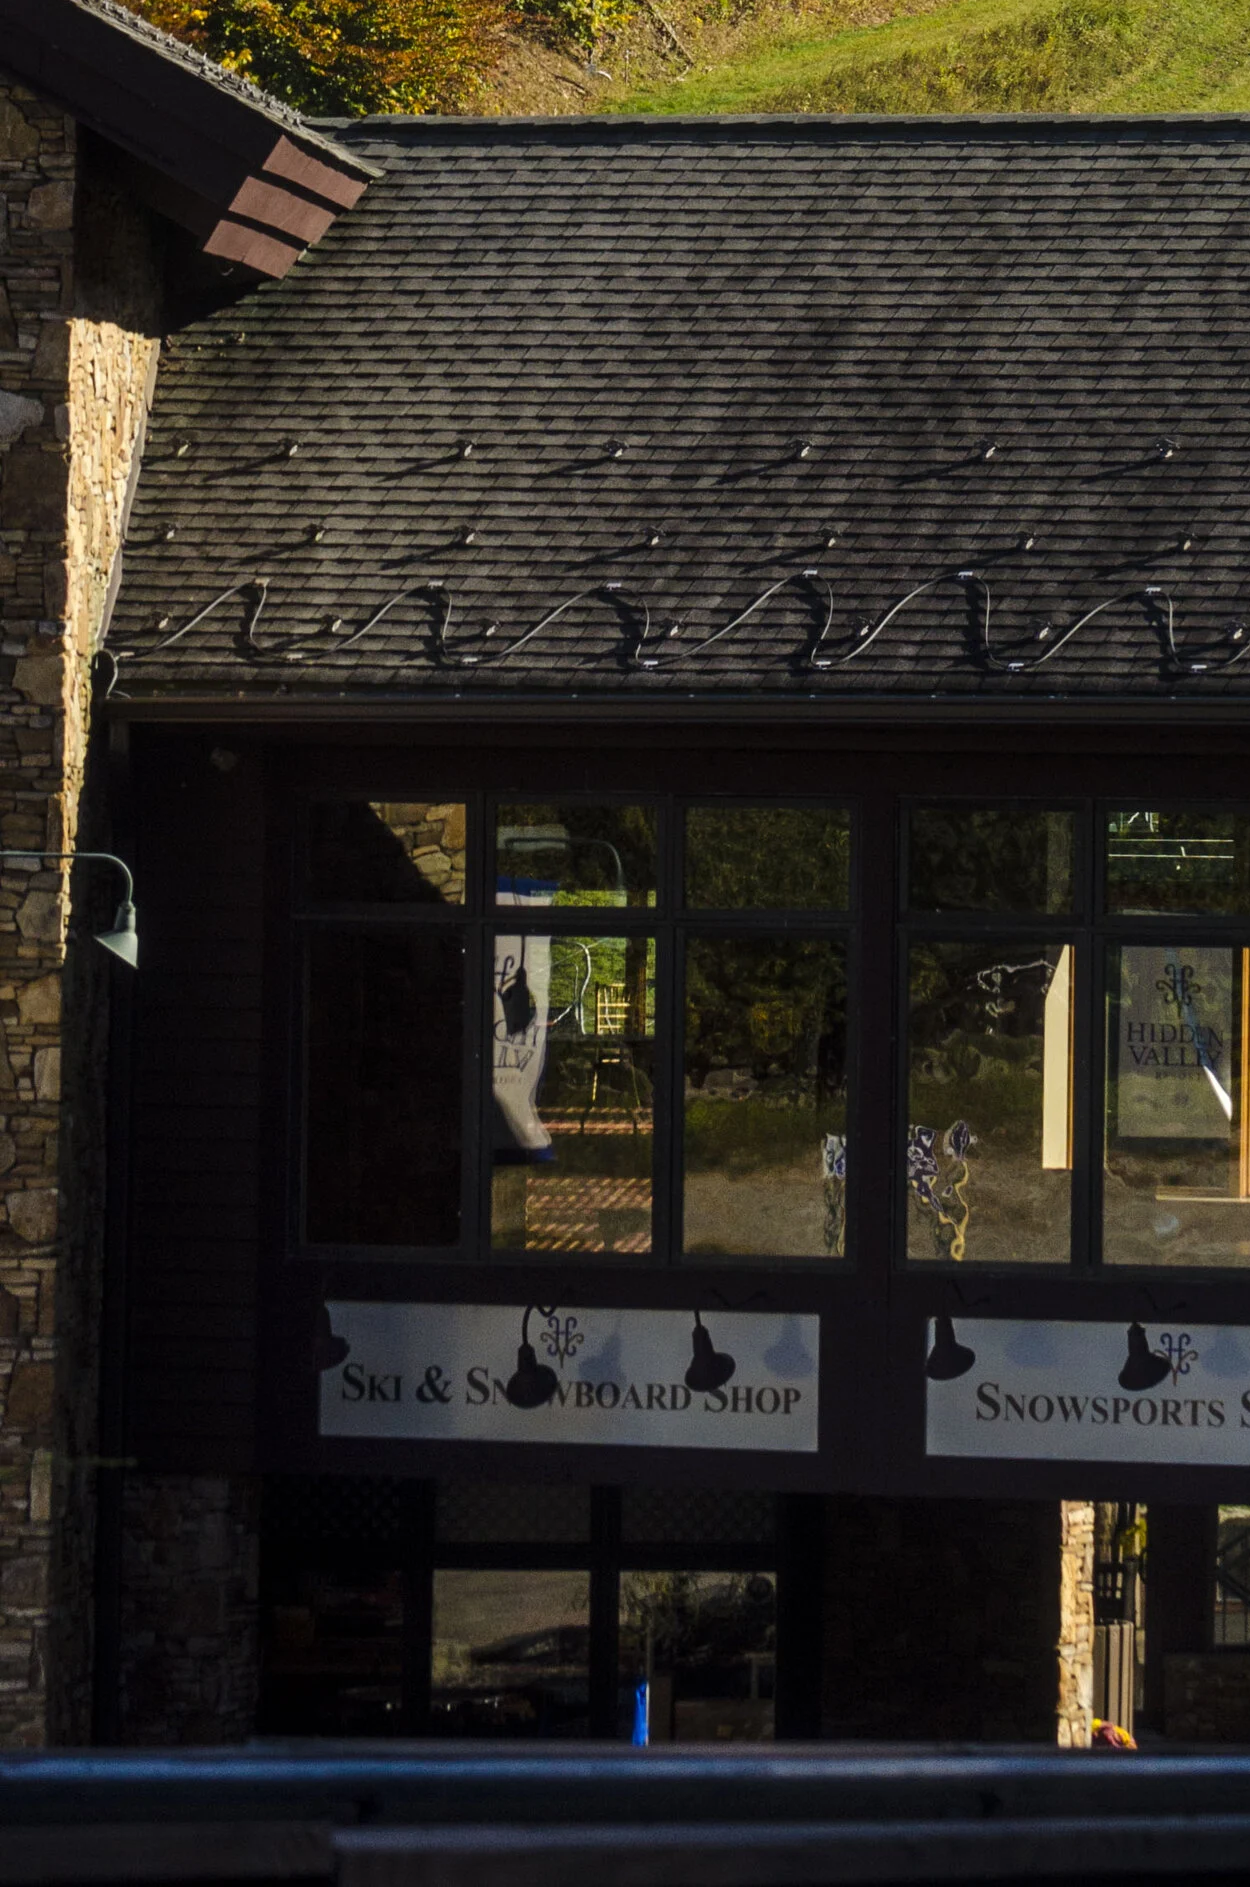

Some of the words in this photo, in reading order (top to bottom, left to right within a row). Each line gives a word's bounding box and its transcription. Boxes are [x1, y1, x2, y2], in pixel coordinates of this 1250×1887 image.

[415, 1365, 451, 1403] &
[466, 1367, 691, 1410] SNWBOARD
[976, 1382, 1225, 1428] SNOWSPORTS
